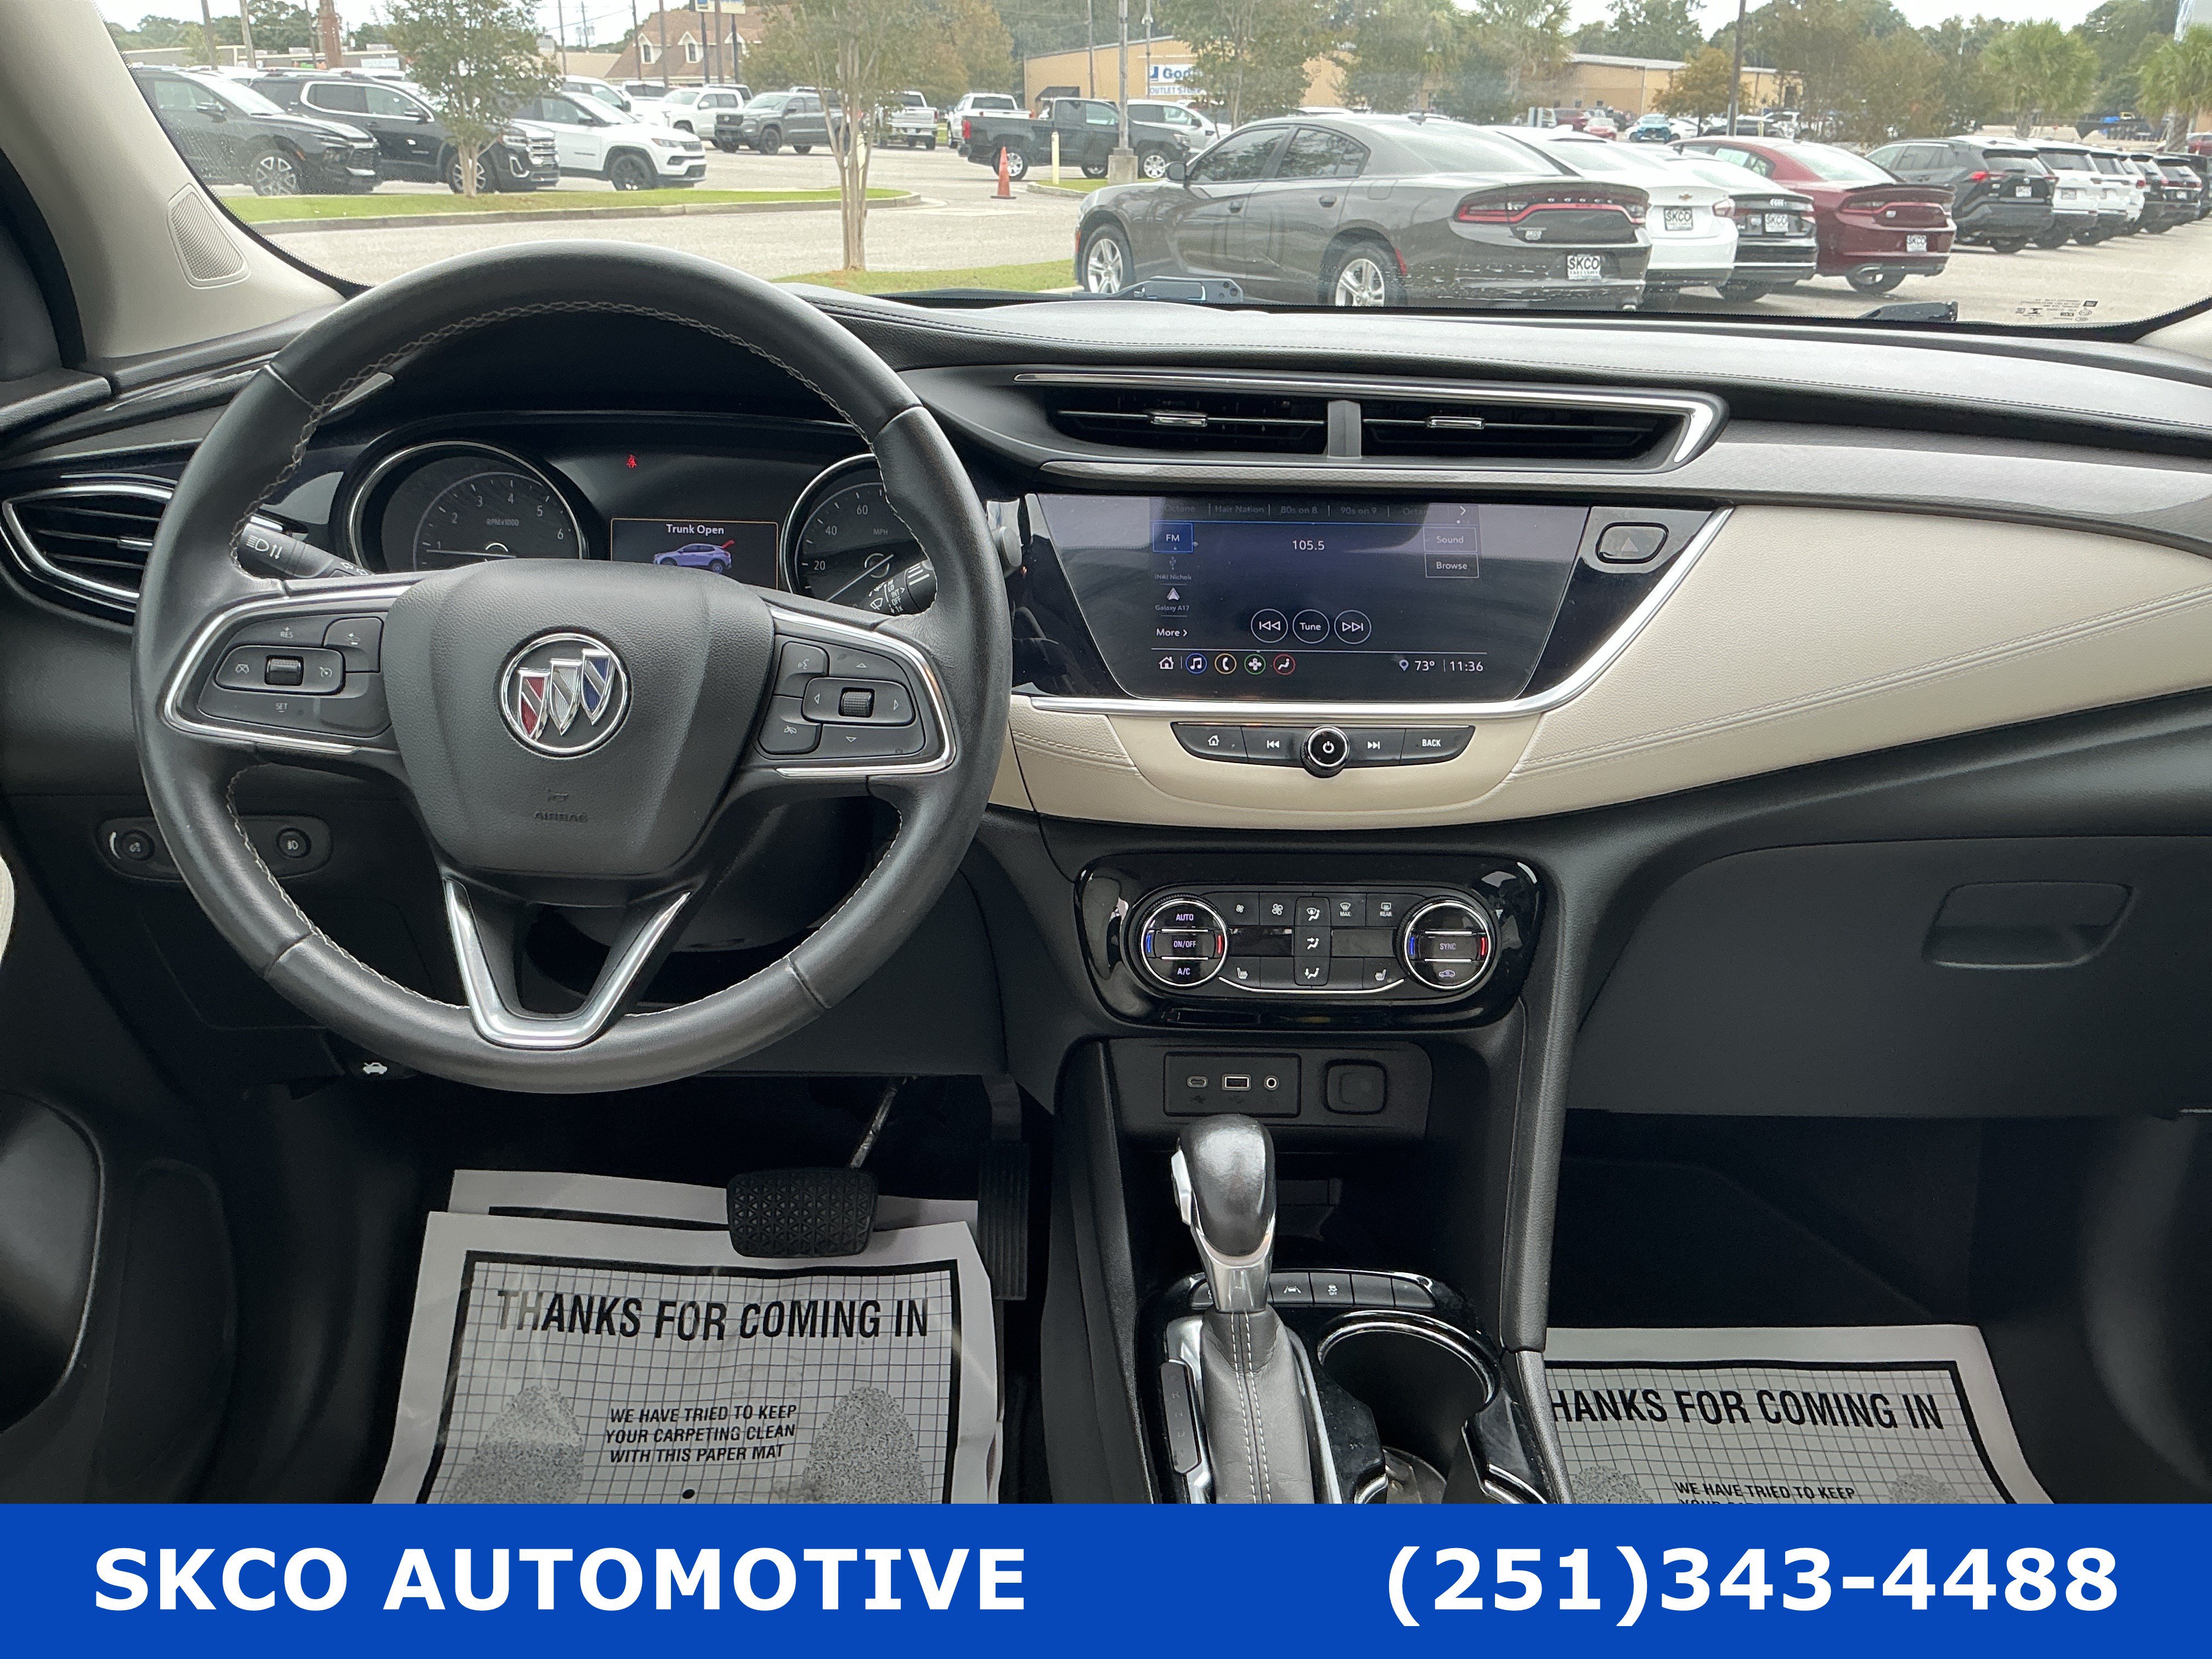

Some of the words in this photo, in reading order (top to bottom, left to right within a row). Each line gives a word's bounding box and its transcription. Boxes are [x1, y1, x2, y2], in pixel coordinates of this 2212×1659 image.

[1665, 211, 1691, 222] SKCO
[1568, 257, 1600, 270] SKCO
[477, 496, 483, 507] 3
[507, 493, 515, 504] 4
[537, 506, 544, 517] 5
[856, 505, 868, 516] 60
[1280, 505, 1295, 515] 80s
[1340, 506, 1355, 515] 90s
[1371, 506, 1378, 515] 9
[452, 513, 459, 524] 2
[556, 529, 564, 540] 6
[667, 524, 695, 534] Trunk
[697, 524, 724, 536] Open
[826, 525, 838, 537] 40
[1166, 534, 1180, 543] FM
[1436, 535, 1464, 544] Sound
[1292, 540, 1325, 551] 105.5
[814, 560, 826, 572] 20
[1435, 562, 1468, 571] Browse
[888, 584, 895, 592] LO
[891, 588, 900, 599] INT
[891, 596, 901, 606] OFF
[1299, 622, 1322, 631] Tune
[1156, 628, 1180, 637] More
[1414, 661, 1435, 671] 73°
[1449, 661, 1483, 672] 11:36
[1422, 738, 1441, 747] BACK
[1176, 913, 1194, 922] AUTO
[1173, 940, 1197, 949] ON/OFF
[1440, 943, 1457, 951] SYNC
[1177, 967, 1191, 976] A/C
[498, 1290, 642, 1338] THANKS
[654, 1300, 727, 1341] FOR
[740, 1300, 881, 1339] COMING
[895, 1299, 928, 1337] IN
[610, 1409, 635, 1423] WE
[639, 1408, 679, 1423] HAVE
[684, 1407, 728, 1421] TRIED
[735, 1406, 754, 1420] TO
[759, 1404, 797, 1419] KEEP
[1550, 1389, 1668, 1422] HANKS
[1675, 1390, 1751, 1425] FOR
[1757, 1390, 1898, 1430] COMING
[1903, 1394, 1944, 1430] IN
[606, 1429, 648, 1444] YOUR
[653, 1426, 741, 1443] CARPETING
[746, 1424, 795, 1440] CLEAN
[610, 1449, 650, 1463] WITH
[654, 1447, 692, 1462] THIS
[696, 1446, 748, 1461] PAPER
[752, 1443, 785, 1459] MAT
[1674, 1482, 1699, 1494] WE
[1704, 1483, 1742, 1497] HAVE
[1744, 1485, 1790, 1499] TRIED
[1793, 1486, 1815, 1499] TO
[1819, 1487, 1856, 1500] KEEP
